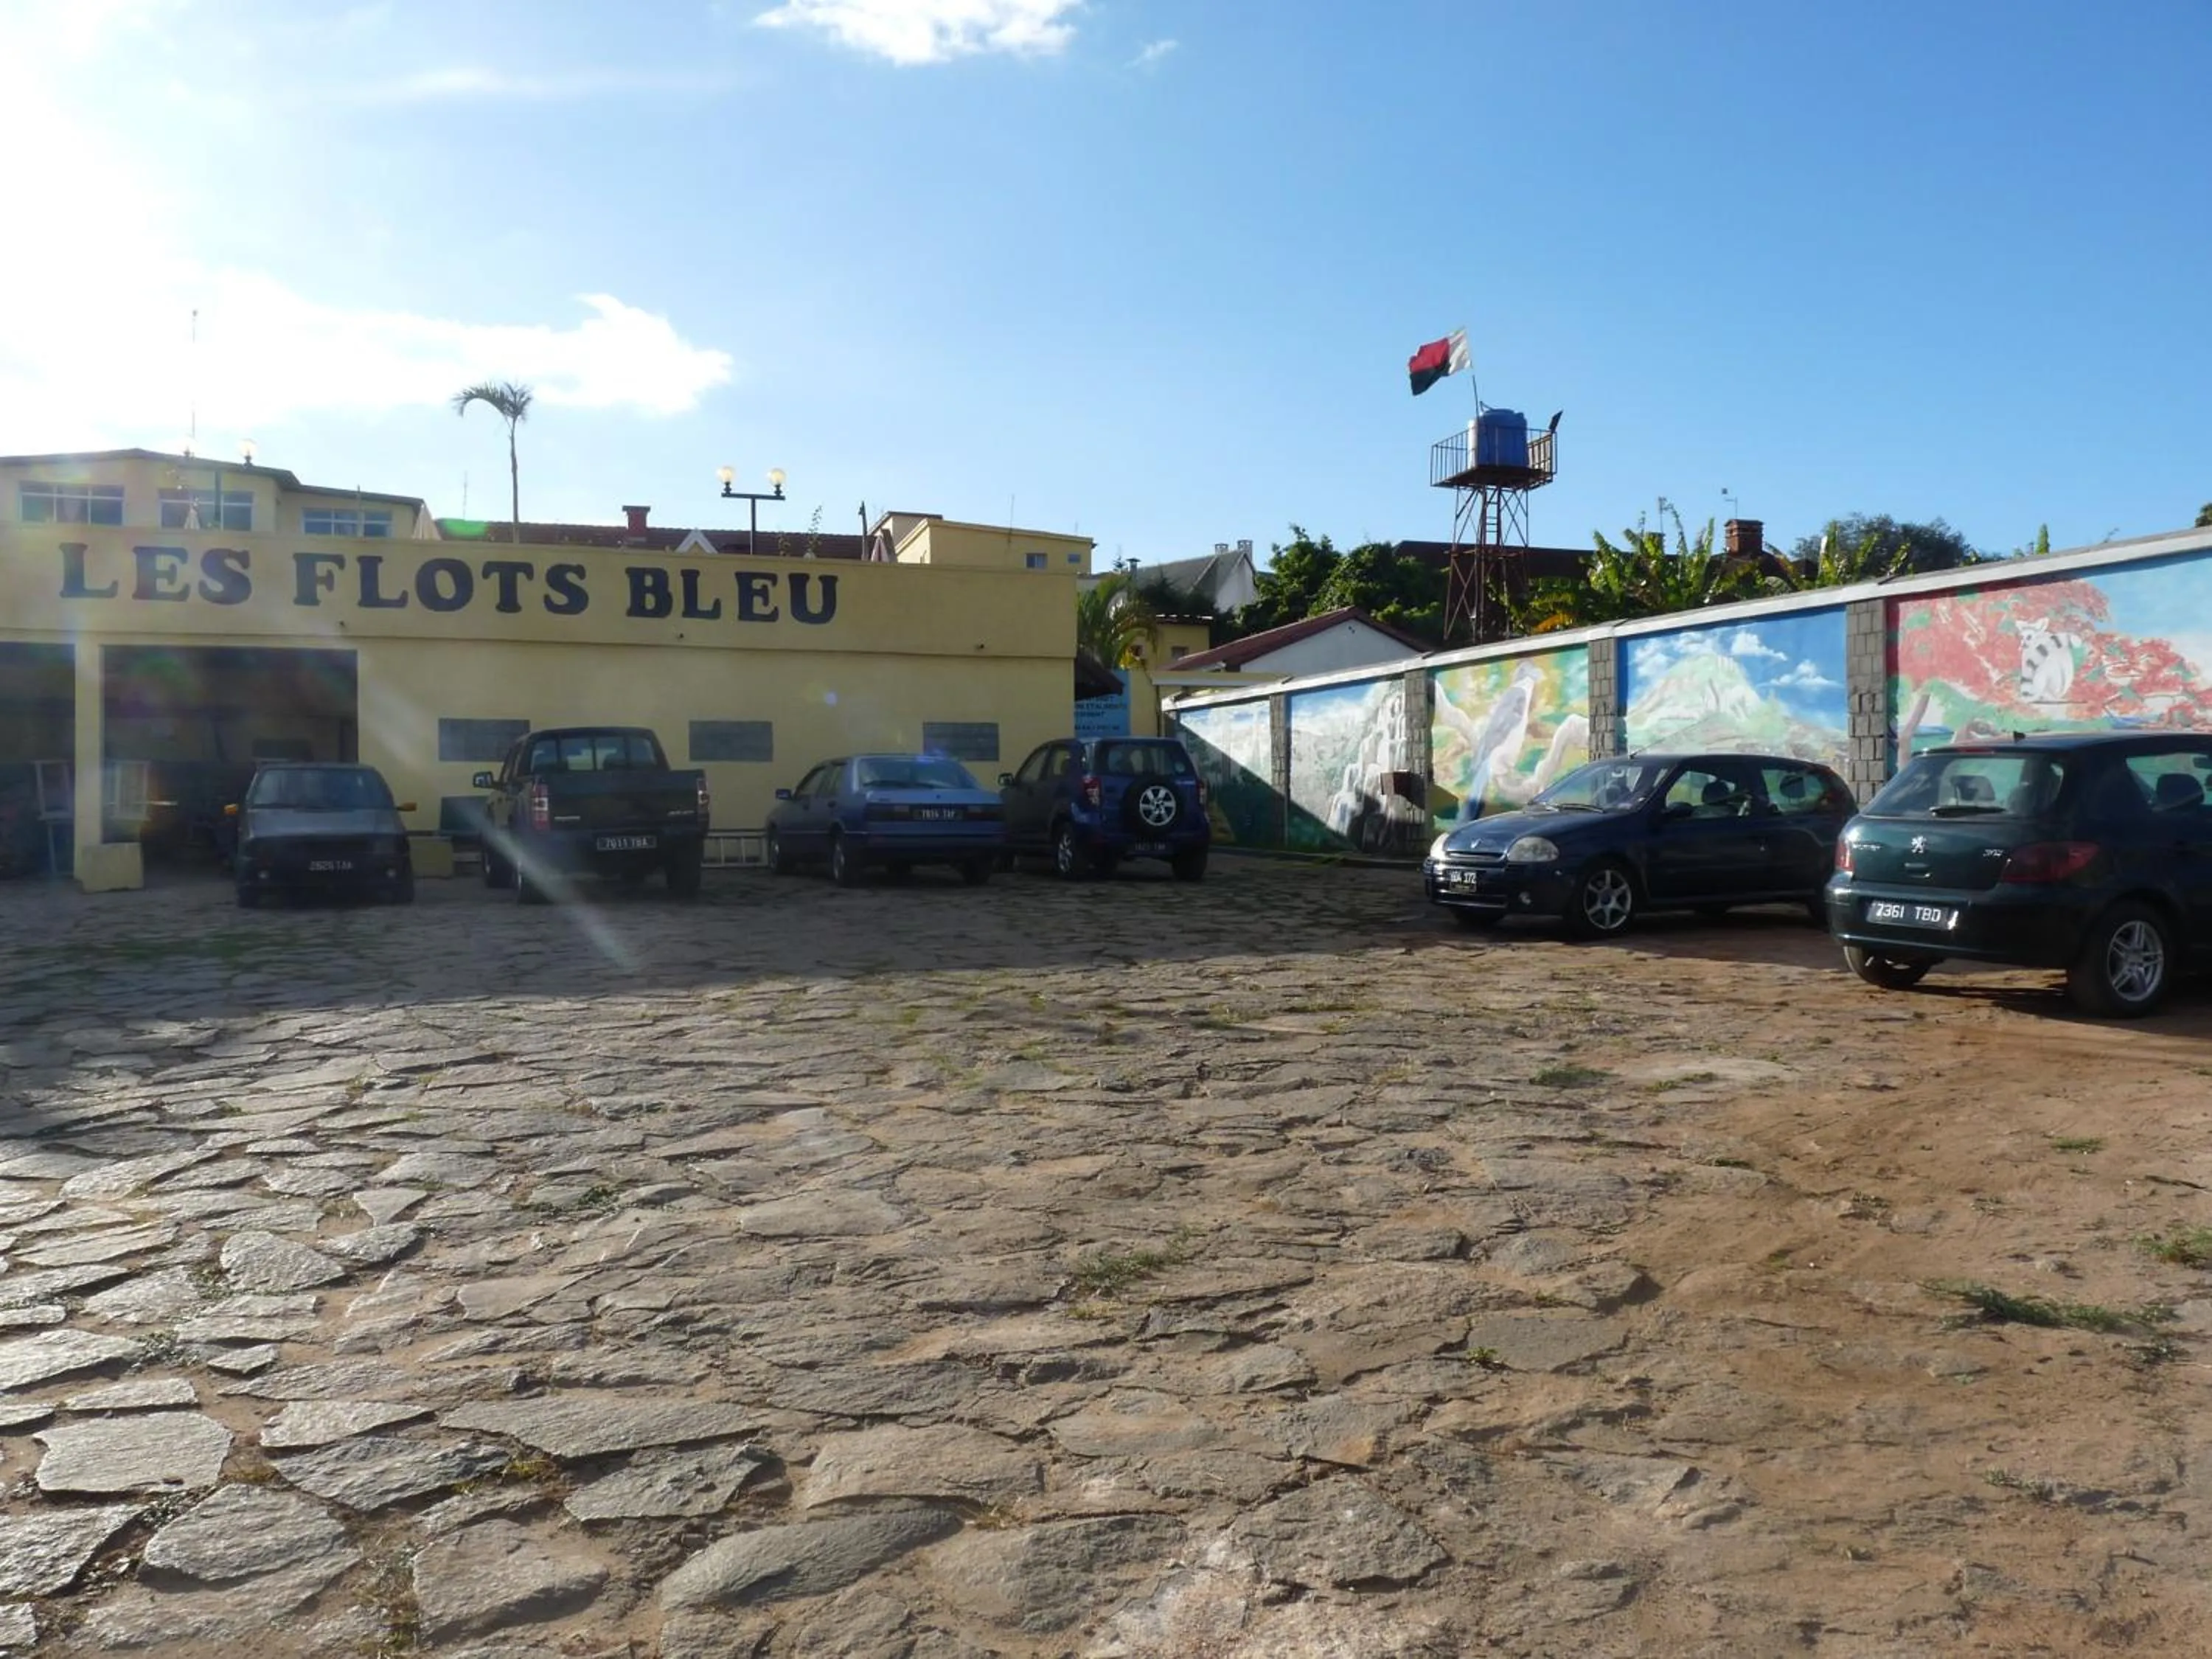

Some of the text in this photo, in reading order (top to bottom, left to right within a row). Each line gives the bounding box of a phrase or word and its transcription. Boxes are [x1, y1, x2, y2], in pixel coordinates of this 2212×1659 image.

[59, 543, 838, 625] LES FLOTS BLEU
[1876, 902, 1941, 922] 7361 TBD
